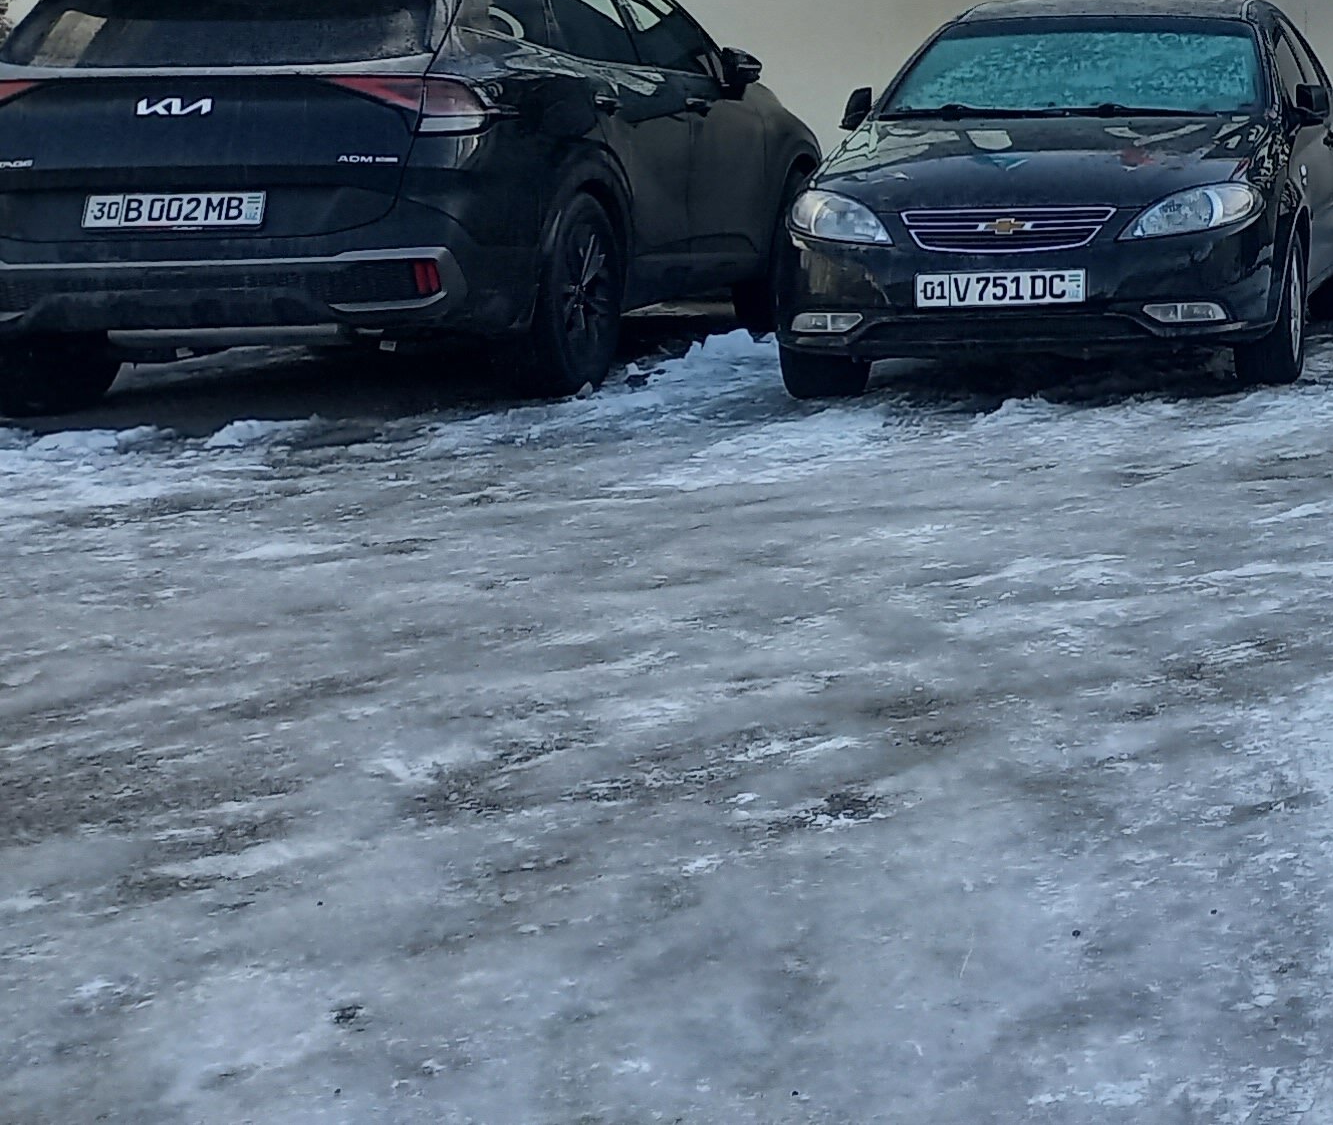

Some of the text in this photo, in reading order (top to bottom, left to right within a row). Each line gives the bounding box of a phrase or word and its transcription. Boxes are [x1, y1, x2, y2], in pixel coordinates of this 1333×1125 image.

[136, 98, 212, 115] KIA
[93, 202, 120, 220] 30
[923, 280, 947, 300] 01
